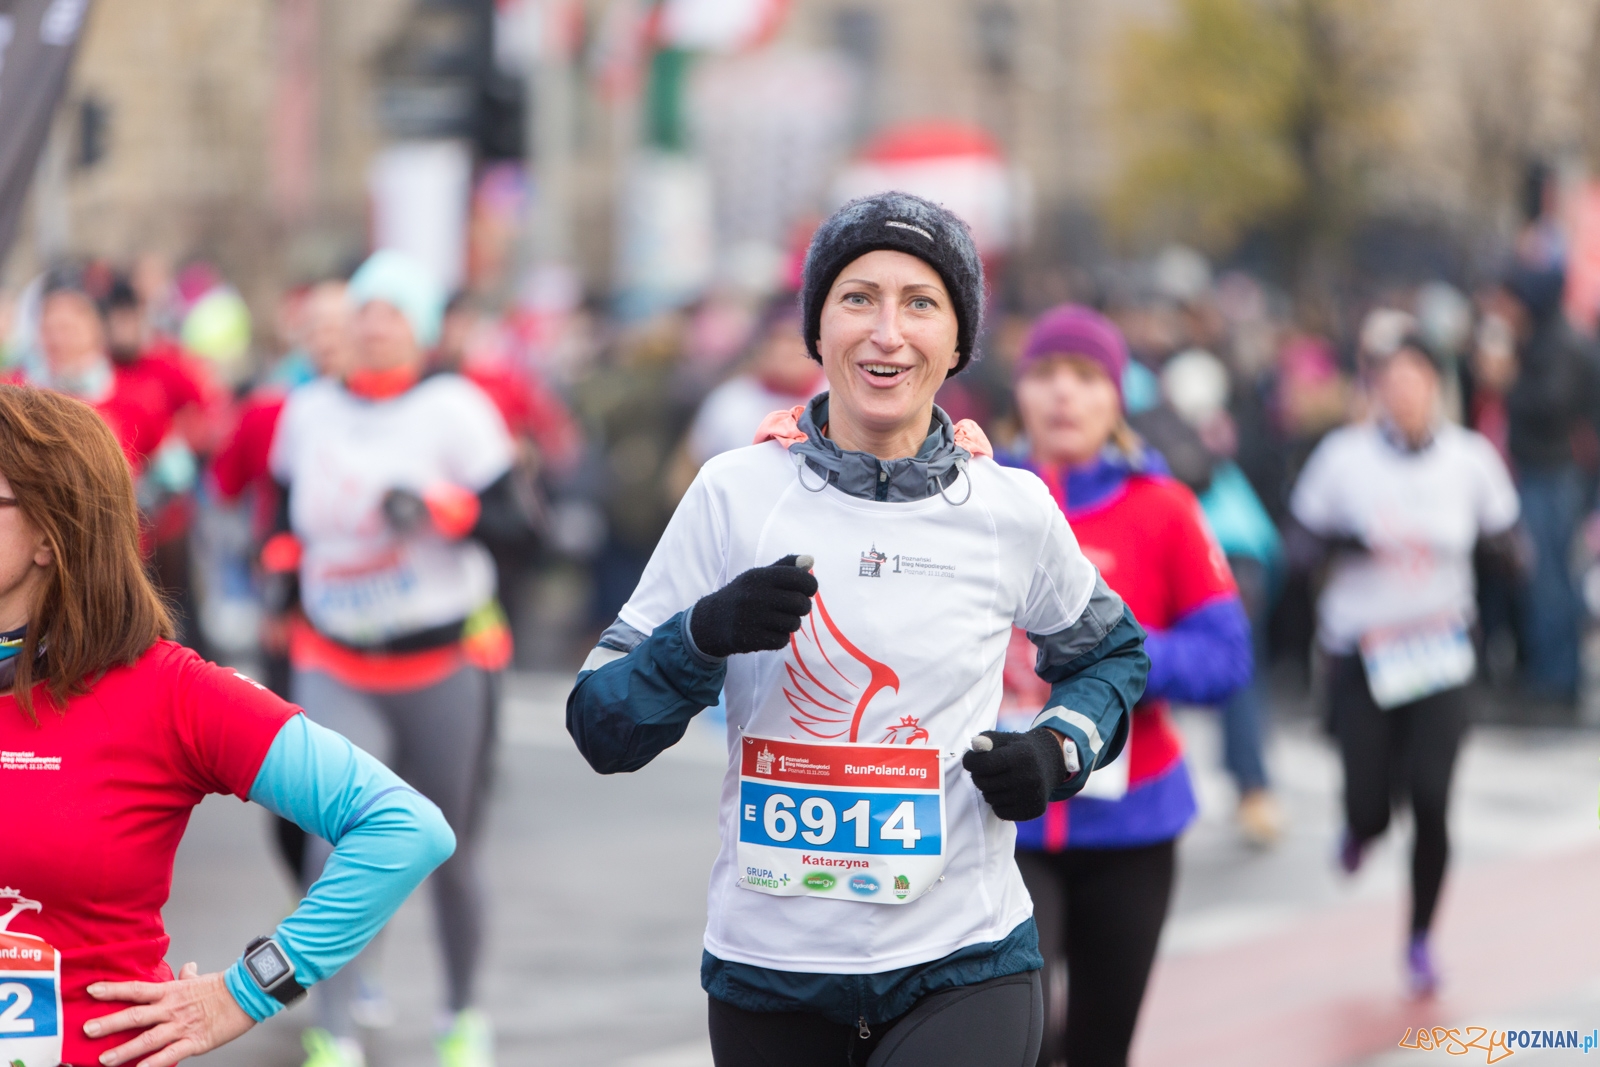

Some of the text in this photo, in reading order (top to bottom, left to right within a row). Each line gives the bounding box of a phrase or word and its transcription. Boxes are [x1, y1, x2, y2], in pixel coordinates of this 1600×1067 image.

[892, 554, 902, 573] 1
[778, 755, 787, 772] 1
[844, 764, 927, 779] RunPoland.org
[744, 793, 922, 849] E 6914
[801, 854, 870, 870] Katarzyna
[746, 866, 774, 879] GRUPA
[747, 875, 779, 889] LUXMED
[807, 878, 834, 888] energy
[0, 946, 42, 962] nd.org
